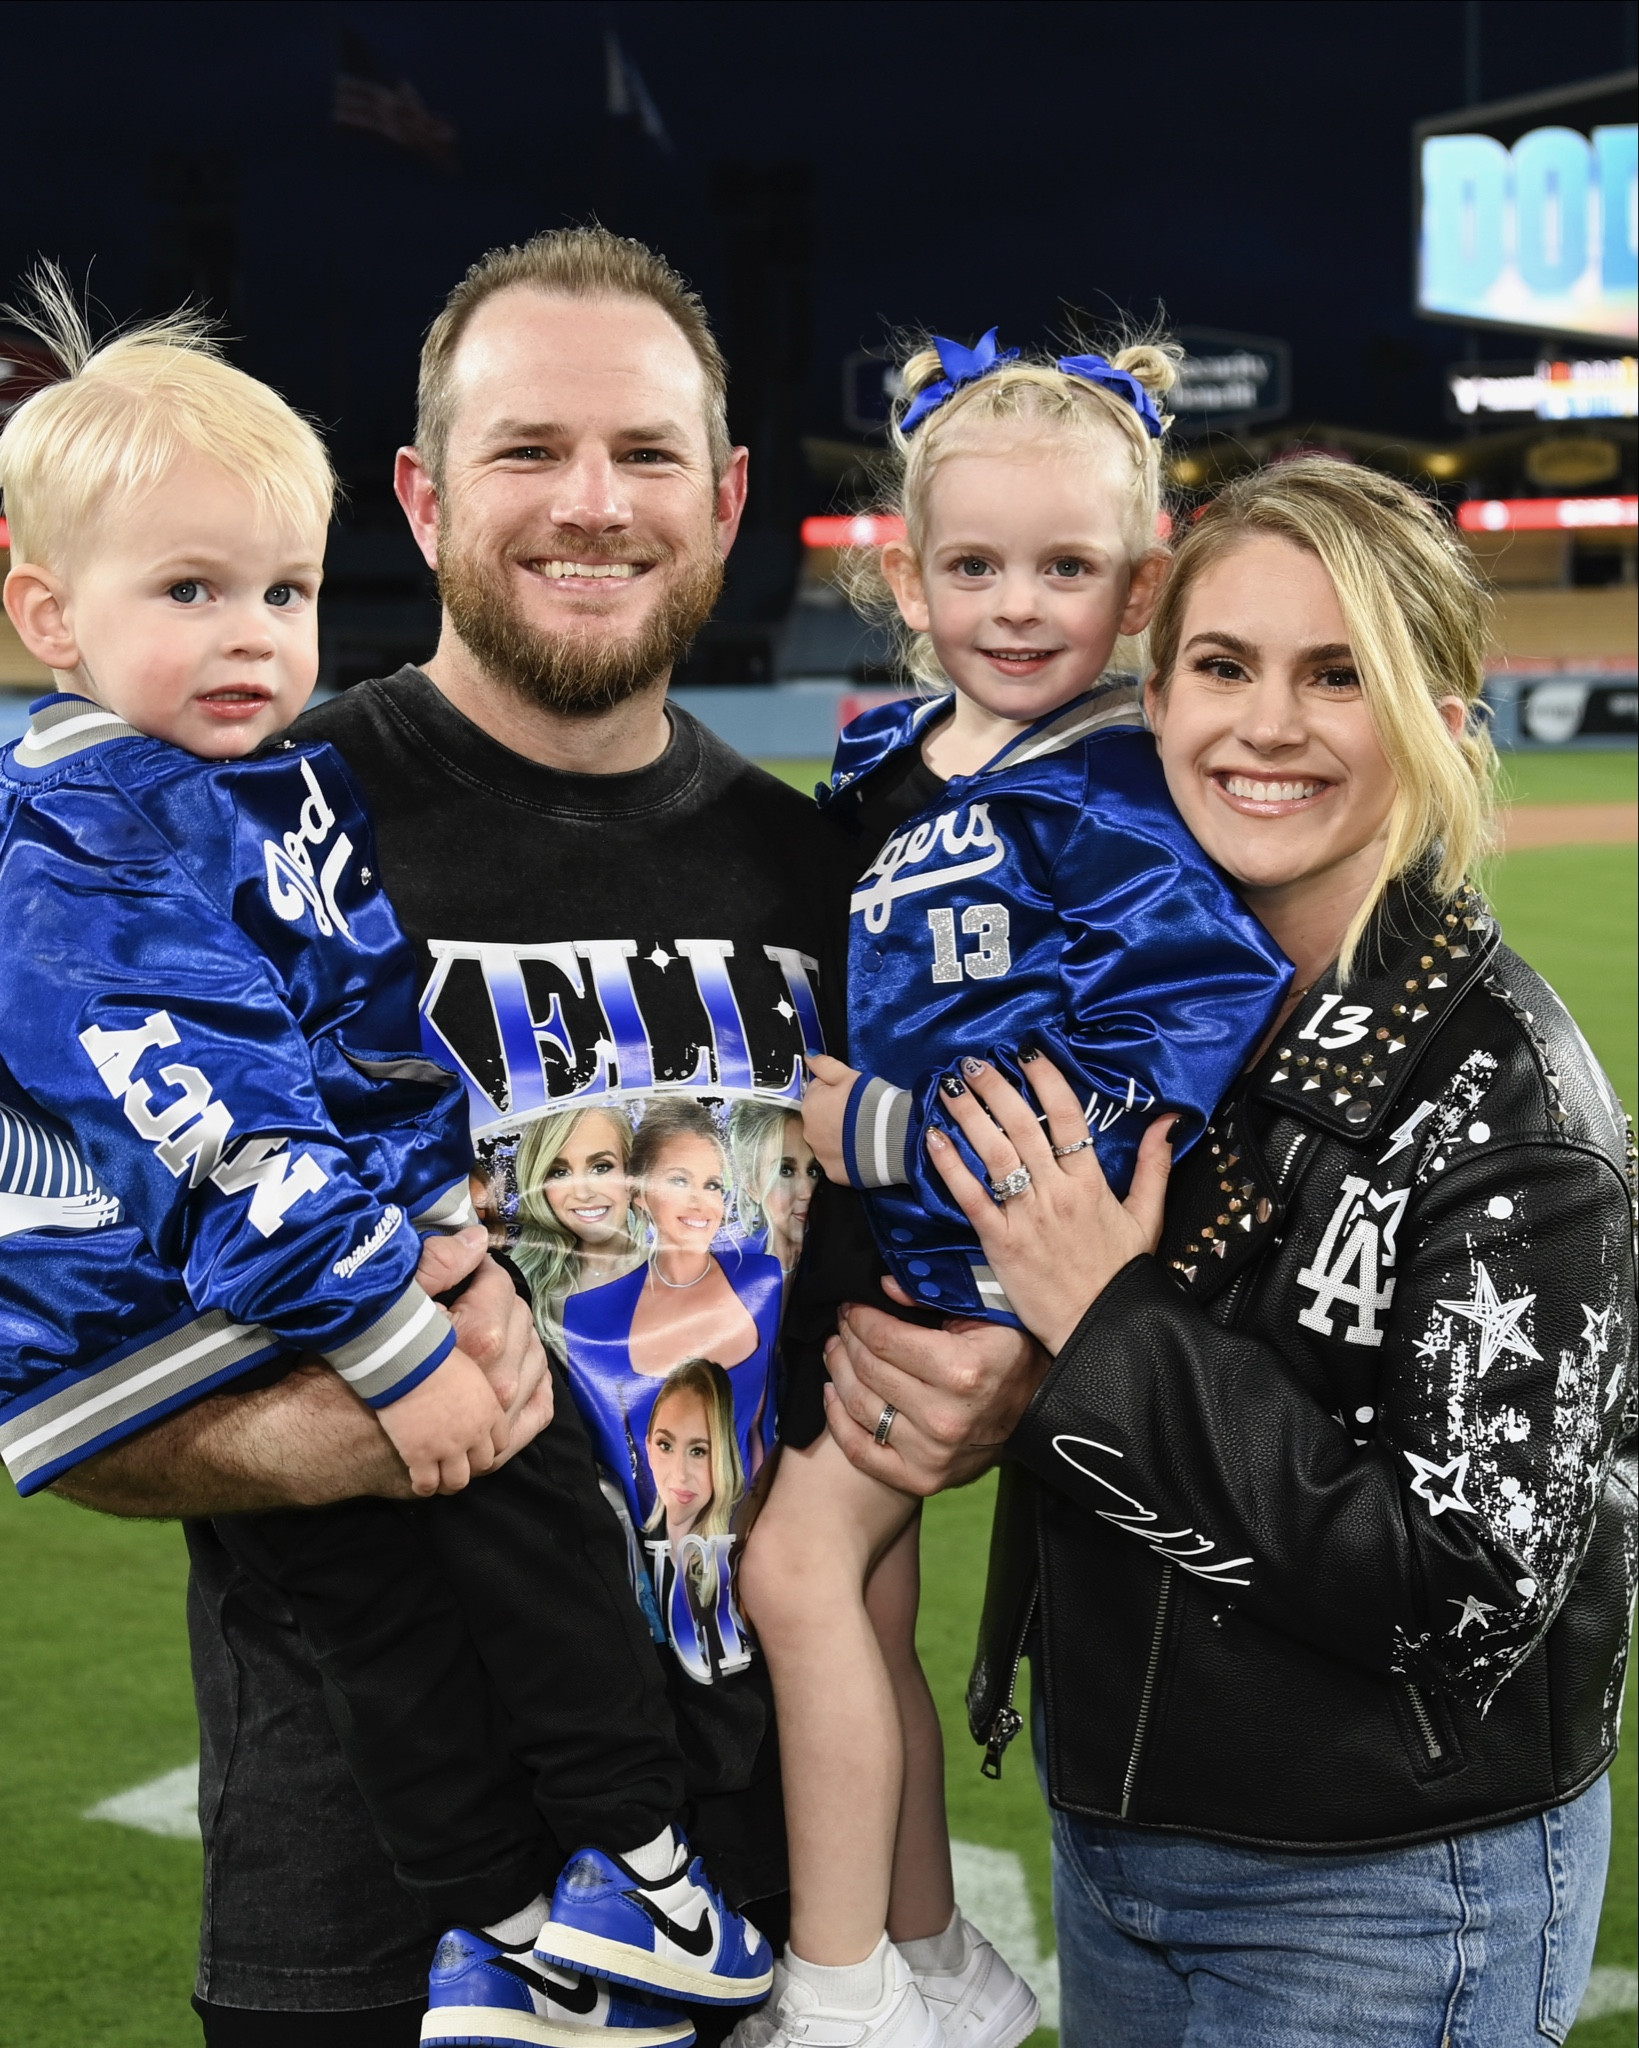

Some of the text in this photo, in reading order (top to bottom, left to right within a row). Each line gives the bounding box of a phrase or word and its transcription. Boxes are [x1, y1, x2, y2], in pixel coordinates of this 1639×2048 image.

[857, 802, 998, 934] gers
[926, 903, 1011, 983] 13
[1298, 994, 1374, 1049] 13
[78, 1009, 329, 1238] MNCY
[1297, 1175, 1396, 1347] LA
